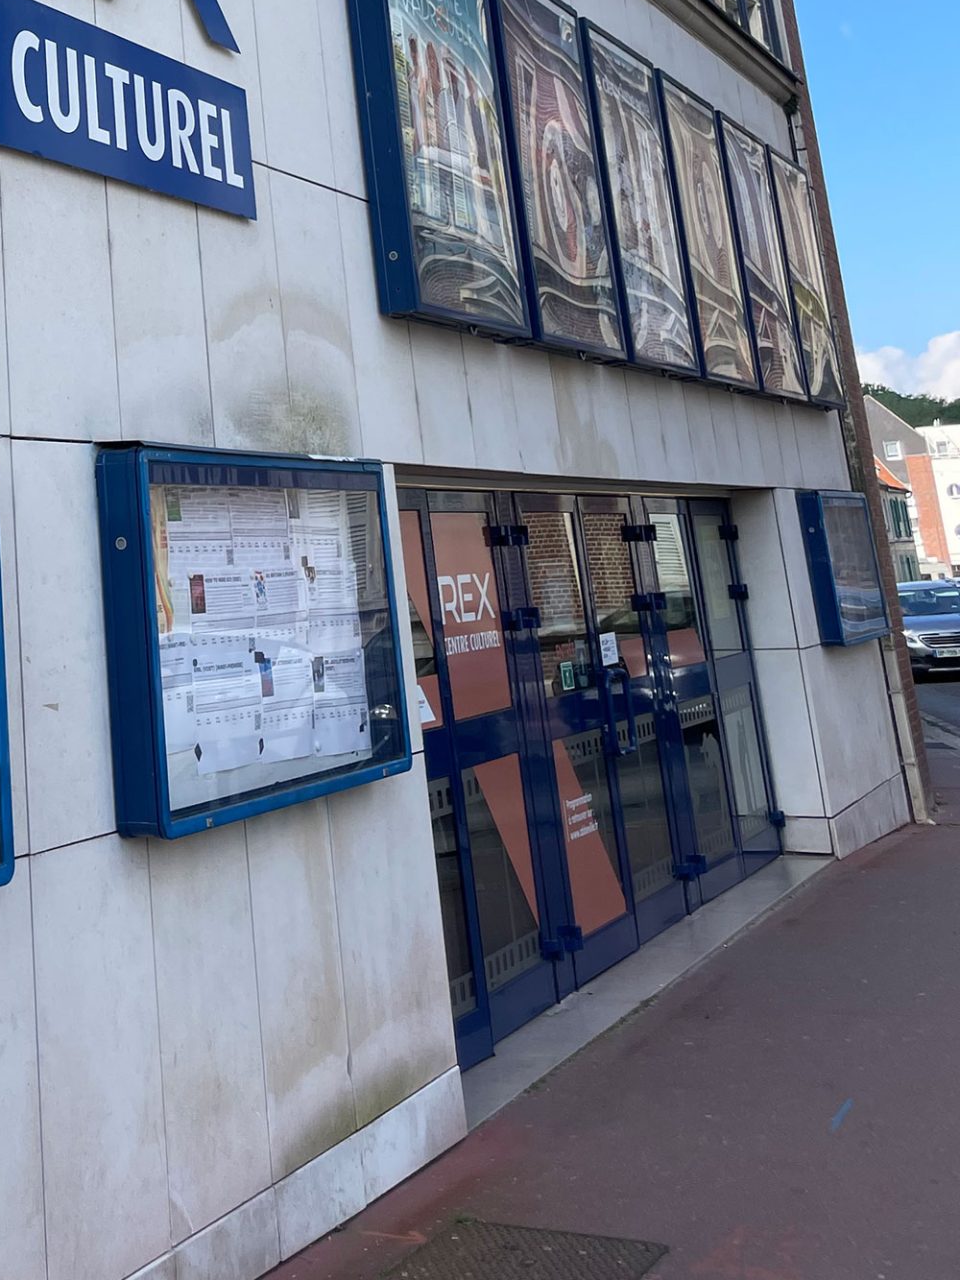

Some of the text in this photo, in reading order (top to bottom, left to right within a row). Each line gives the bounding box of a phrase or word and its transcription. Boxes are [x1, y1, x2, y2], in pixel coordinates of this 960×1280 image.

[11, 29, 244, 189] CULTUREL
[437, 572, 496, 625] REX
[470, 629, 501, 651] CULTUREL
